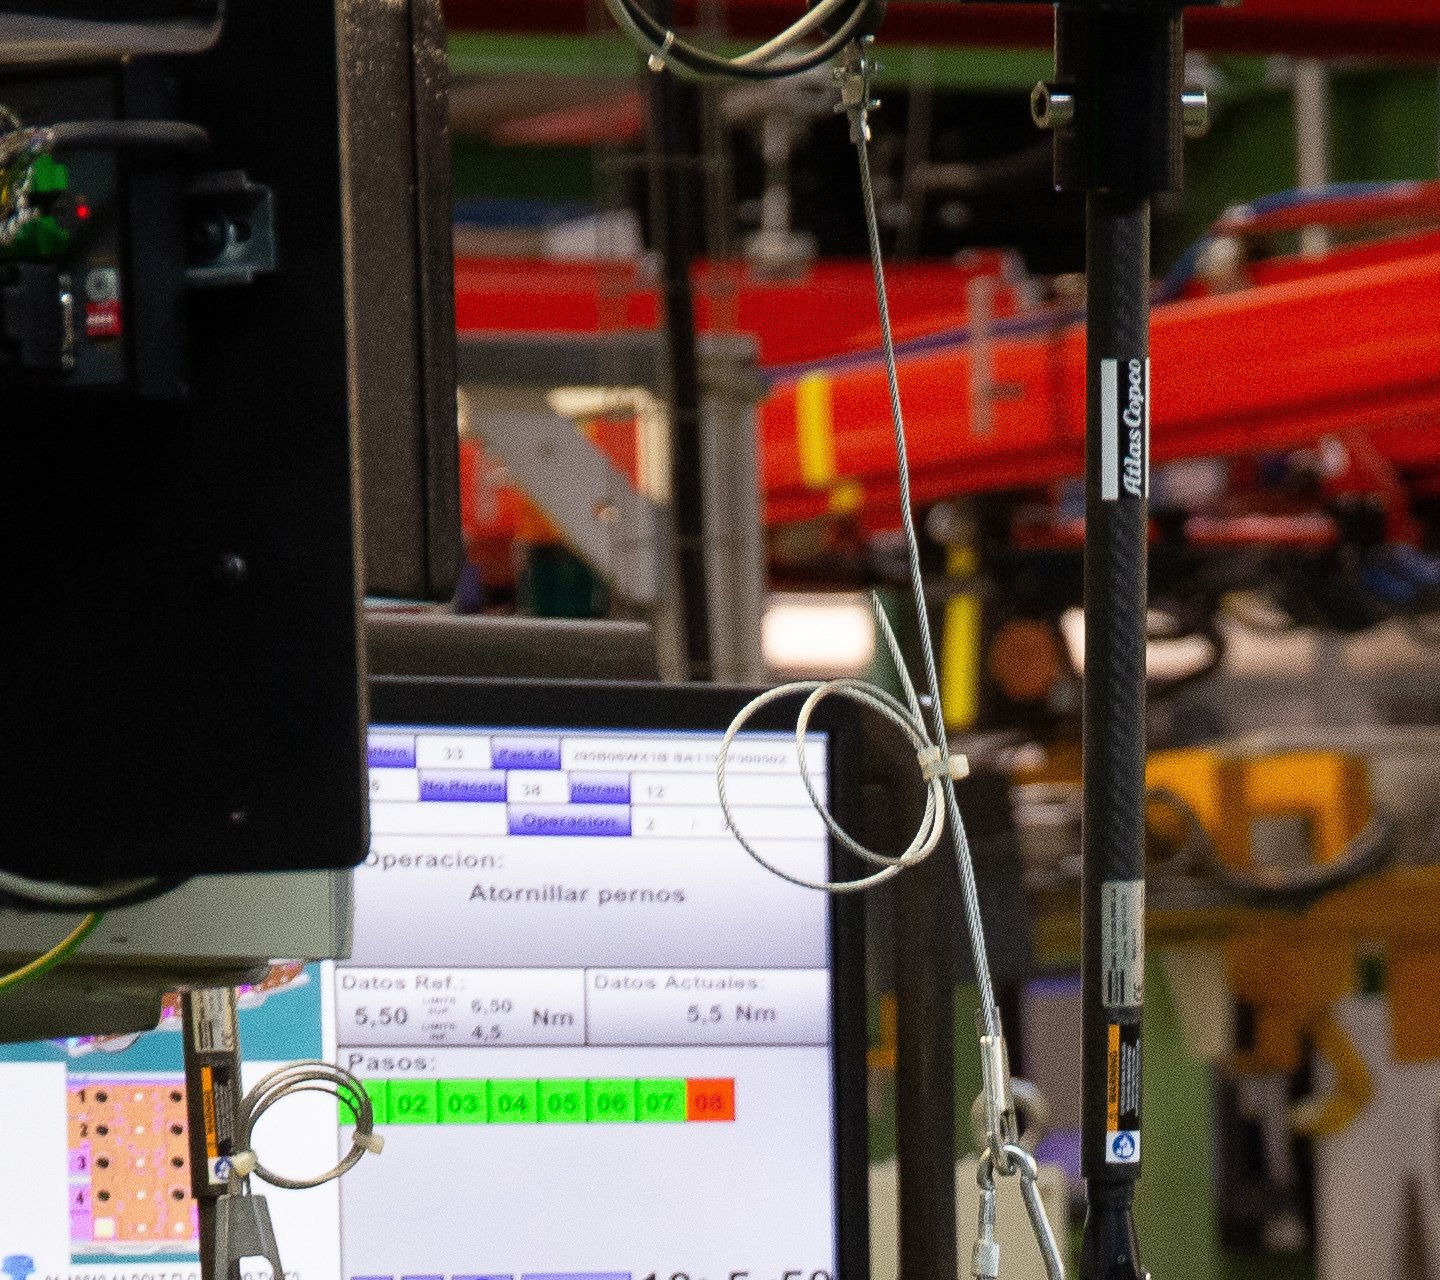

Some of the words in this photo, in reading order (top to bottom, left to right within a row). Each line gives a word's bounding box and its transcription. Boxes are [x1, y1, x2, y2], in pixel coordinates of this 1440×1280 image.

[442, 747, 464, 760] 33
[521, 782, 542, 796] 38
[646, 784, 664, 798] 12
[522, 812, 618, 831] Operacion
[645, 817, 655, 830] 2
[365, 850, 504, 871] Operacion:
[468, 883, 588, 903] Atornillar
[598, 886, 686, 907] pernos
[341, 975, 407, 990] Datos
[594, 975, 657, 990] Datos
[665, 975, 767, 990] Actuales:
[471, 997, 513, 1015] 6,50
[687, 1004, 723, 1023] 5,5
[735, 1005, 777, 1022] Nm
[354, 1007, 409, 1028] 5,50
[532, 1009, 574, 1026] Nm
[471, 1023, 502, 1042] 4,5
[347, 1053, 436, 1072] Pasos:
[77, 1091, 86, 1103] 1
[398, 1094, 428, 1112] 02
[447, 1094, 478, 1112] 03
[496, 1094, 528, 1112] 04
[547, 1094, 577, 1112] 05
[596, 1094, 626, 1112] 06
[645, 1093, 674, 1112] 07
[694, 1093, 723, 1112] 08
[79, 1124, 89, 1137] 2
[77, 1156, 87, 1169] 3
[76, 1192, 85, 1205] 4
